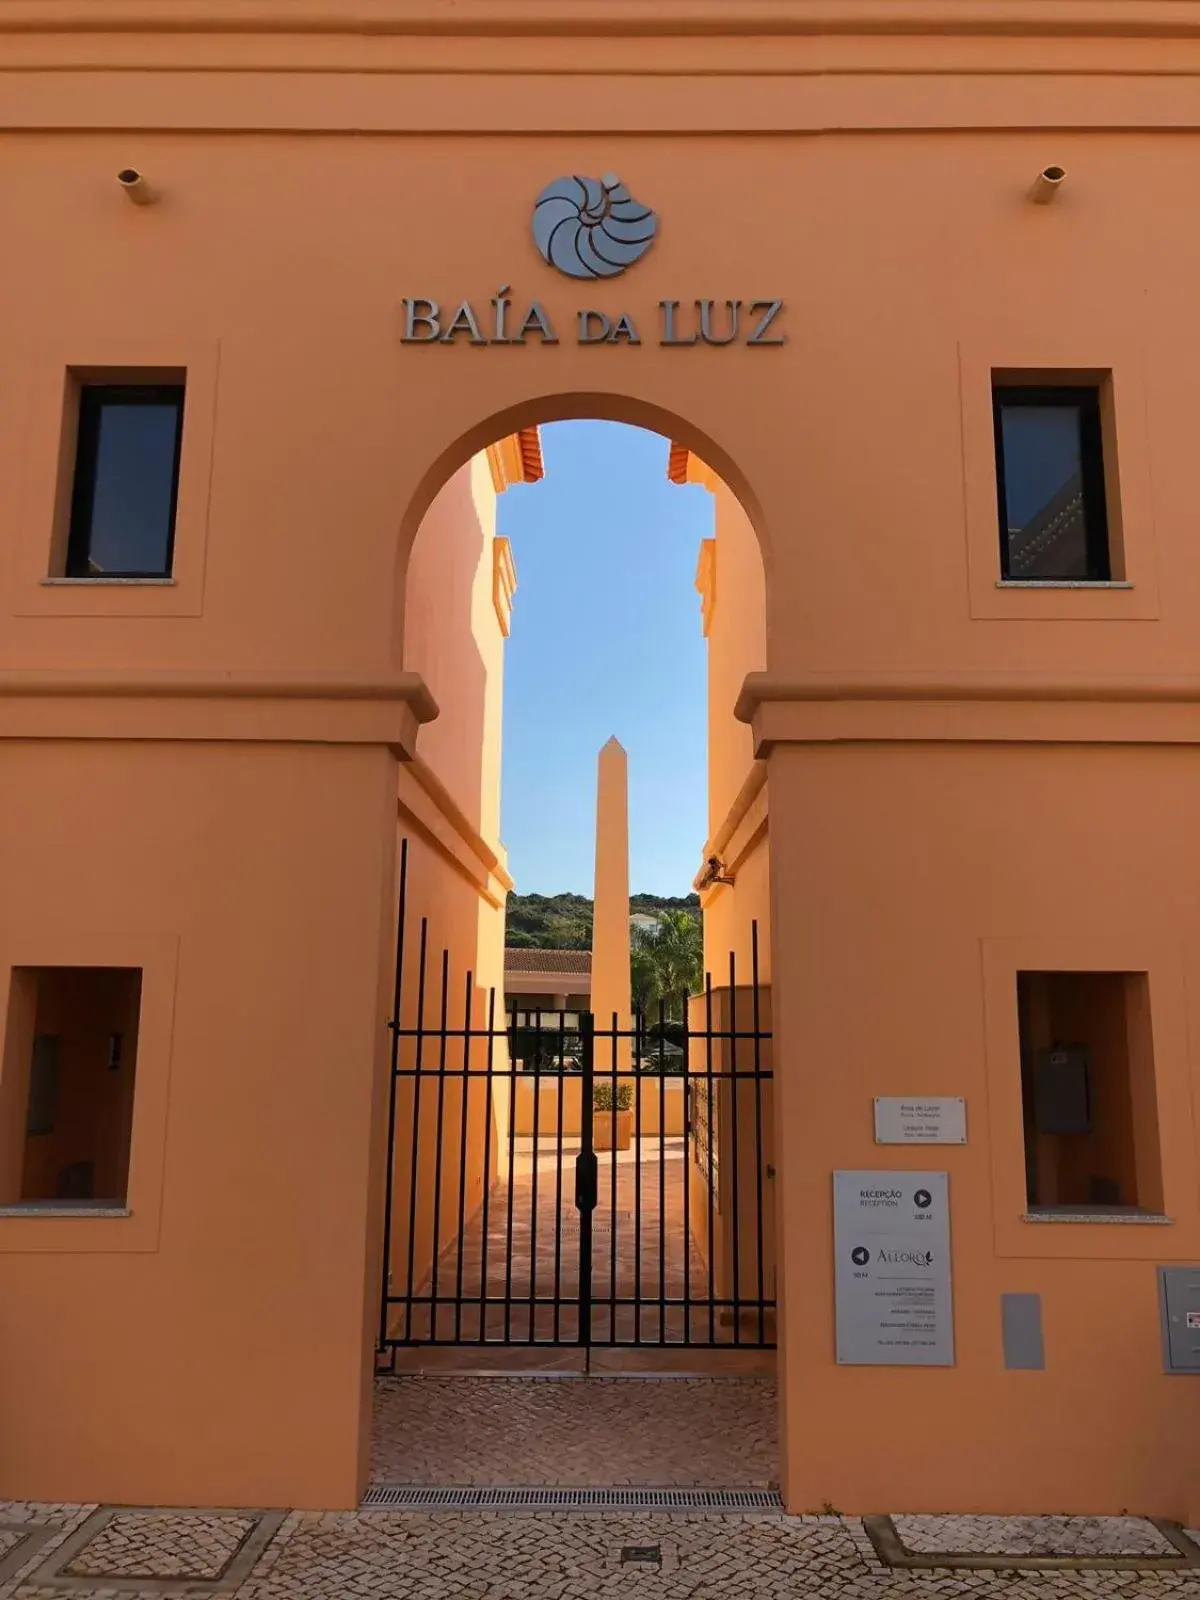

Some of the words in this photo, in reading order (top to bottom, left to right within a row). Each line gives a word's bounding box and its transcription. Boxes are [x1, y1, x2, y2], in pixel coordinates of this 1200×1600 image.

[400, 285, 560, 345] BAÍA
[577, 311, 642, 345] DA
[659, 299, 787, 346] LUZ
